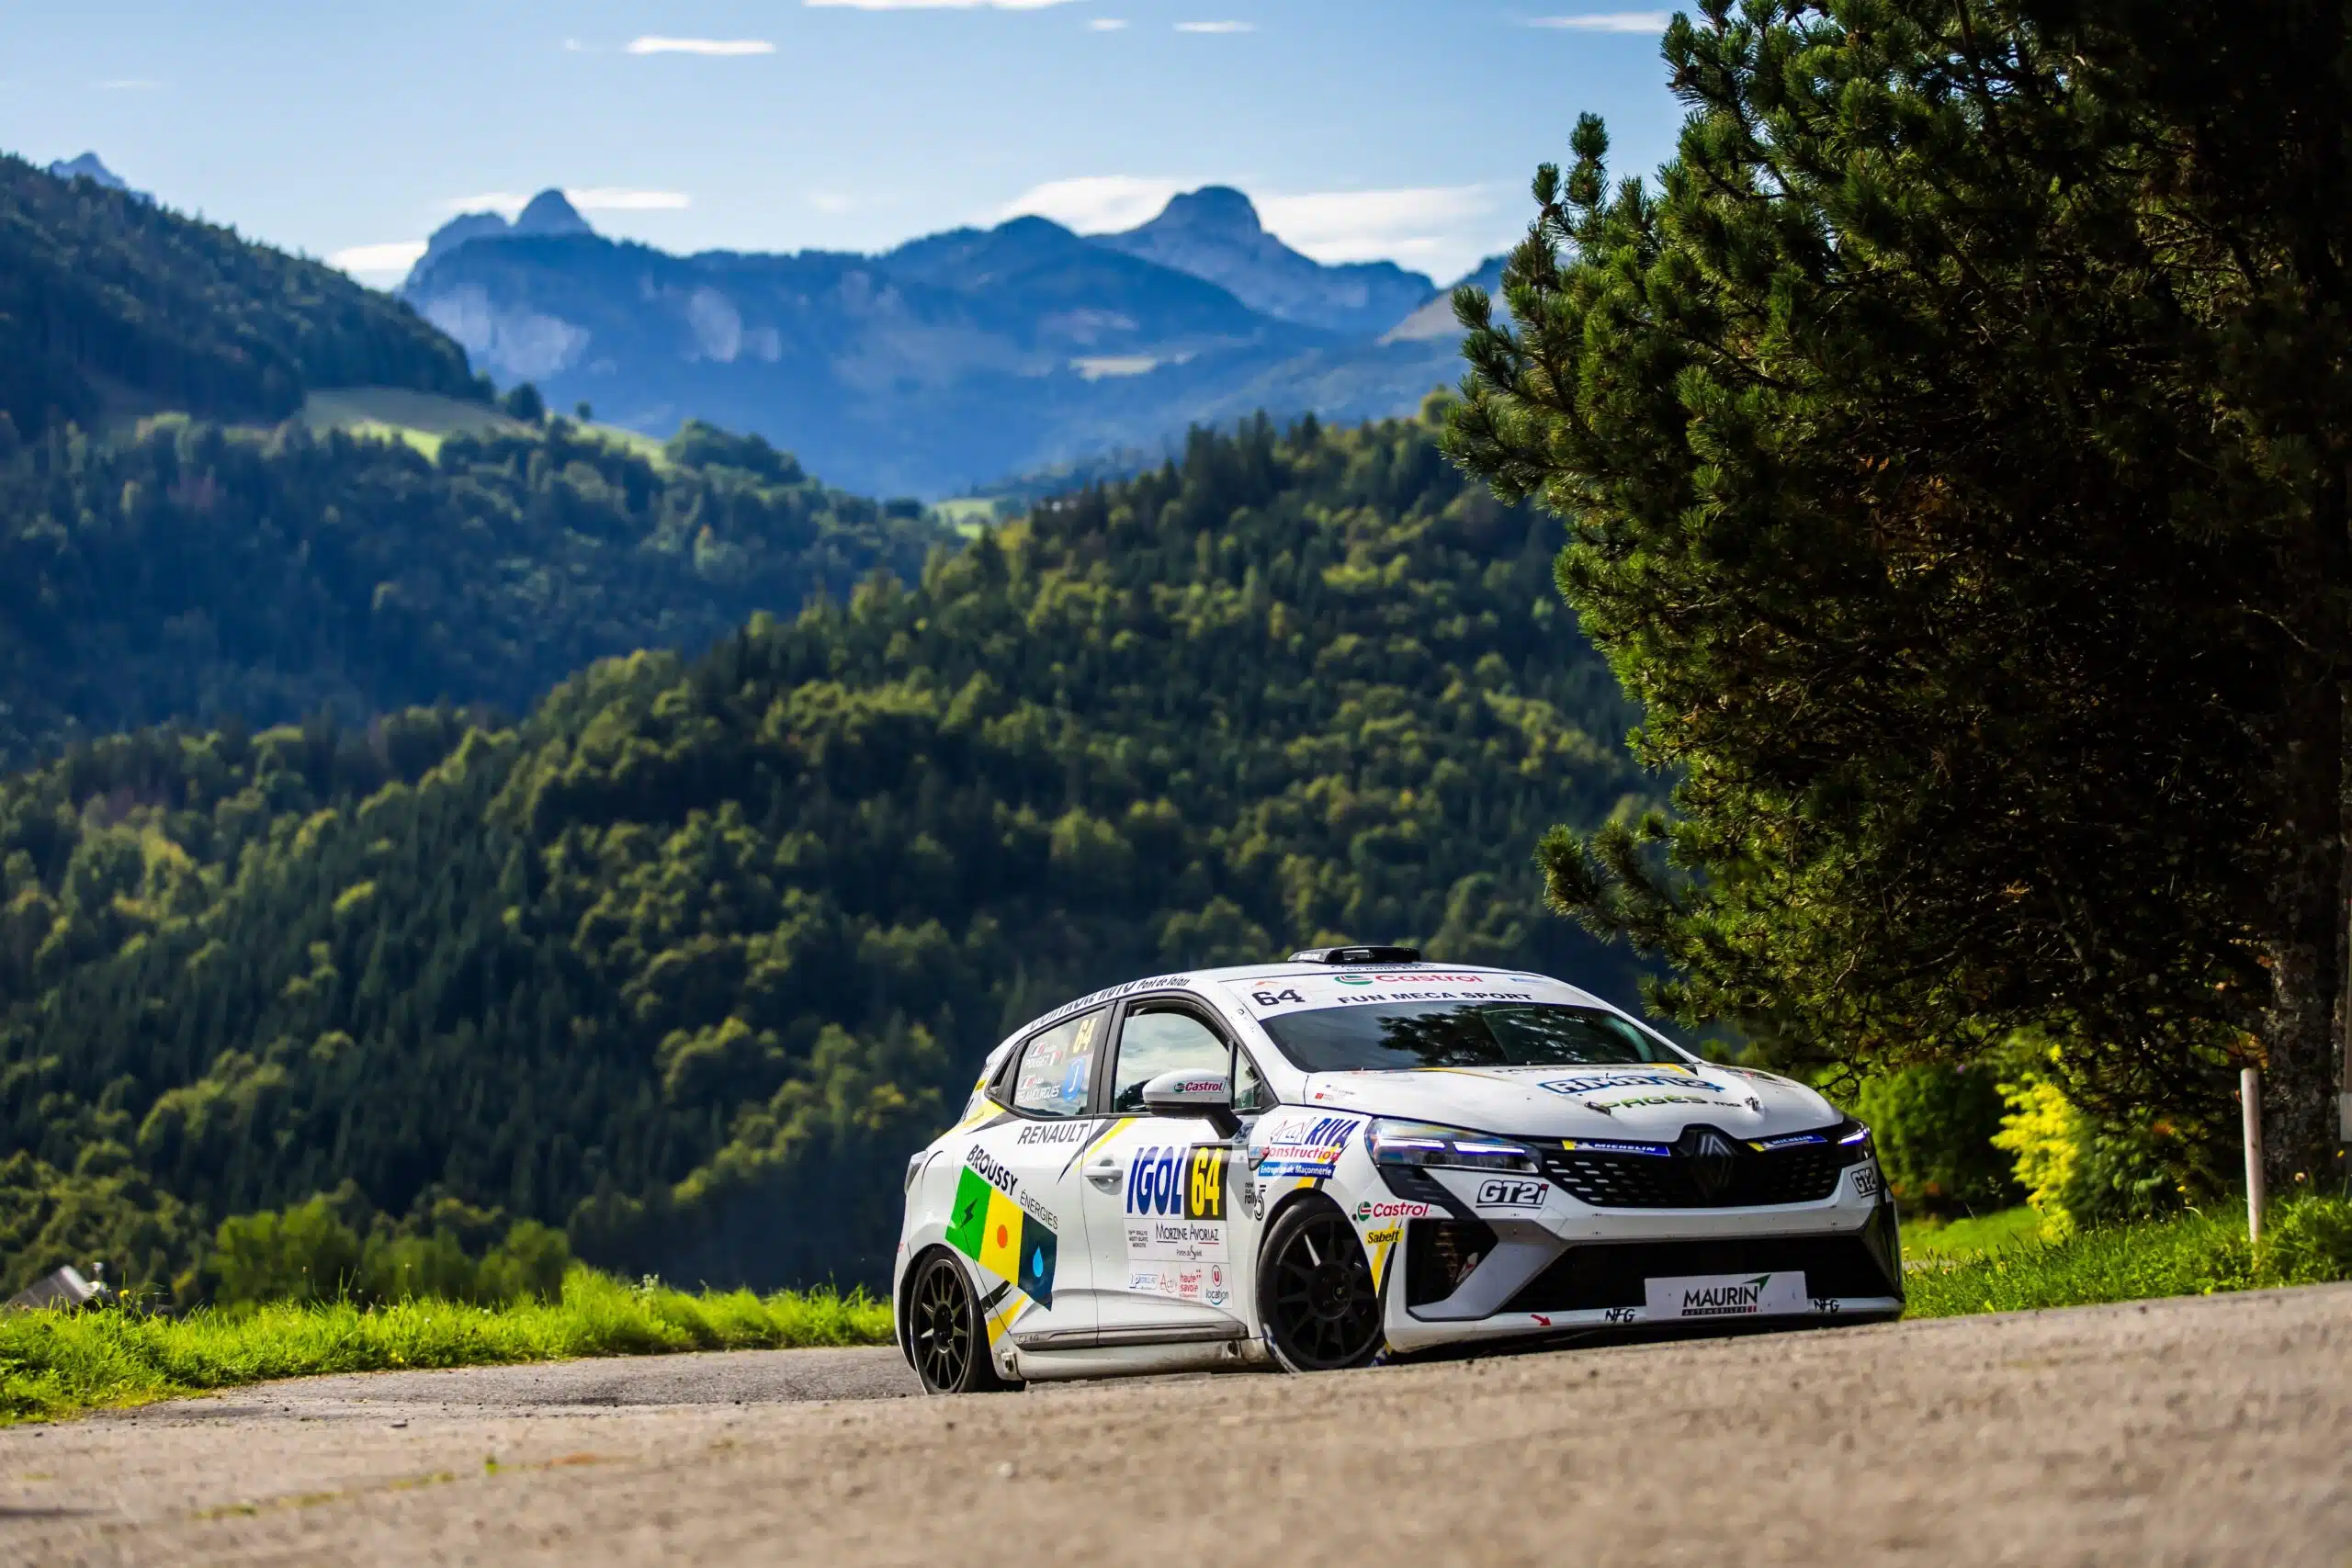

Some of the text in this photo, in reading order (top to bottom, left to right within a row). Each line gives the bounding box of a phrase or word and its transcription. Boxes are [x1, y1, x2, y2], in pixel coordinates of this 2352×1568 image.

[1374, 975, 1484, 983] Castrol
[1251, 989, 1306, 1006] 64
[1338, 992, 1533, 1003] FUN MECA SPORT
[1072, 1018, 1098, 1054] 64
[1185, 1081, 1223, 1091] Castrol
[1017, 1122, 1089, 1145] RENAULT
[1304, 1117, 1361, 1148] RIVA
[1771, 1134, 1814, 1145] MICHELIN
[1594, 1143, 1656, 1153] MICHELIN
[1295, 1164, 1332, 1176] Maçonnerie
[966, 1144, 1058, 1230] BROUSSY ÉNERGIES
[1126, 1145, 1224, 1216] IGOL 64
[1476, 1179, 1549, 1206] GT2i
[1373, 1201, 1430, 1218] Castrol
[1156, 1221, 1219, 1241] MORZINE AVORIAZ
[1367, 1229, 1400, 1244] Sabelt
[1206, 1287, 1229, 1300] location
[1683, 1286, 1758, 1307] MAURIN
